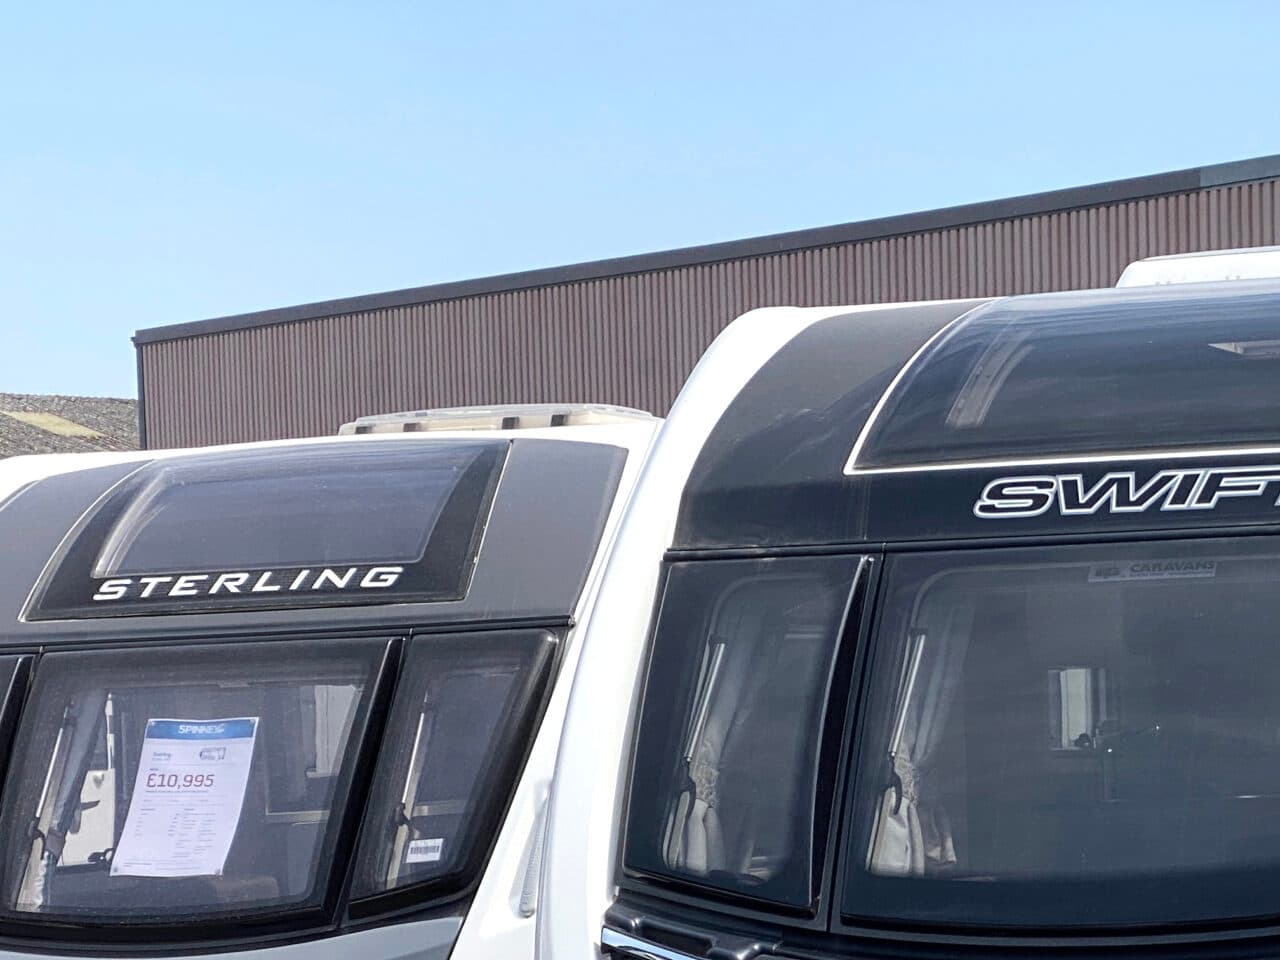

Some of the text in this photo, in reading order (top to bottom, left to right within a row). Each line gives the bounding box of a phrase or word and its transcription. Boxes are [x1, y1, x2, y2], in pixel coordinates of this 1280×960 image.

[1129, 560, 1215, 573] CARAVANS
[92, 567, 404, 600] STERLING
[146, 773, 215, 789] £10,995
